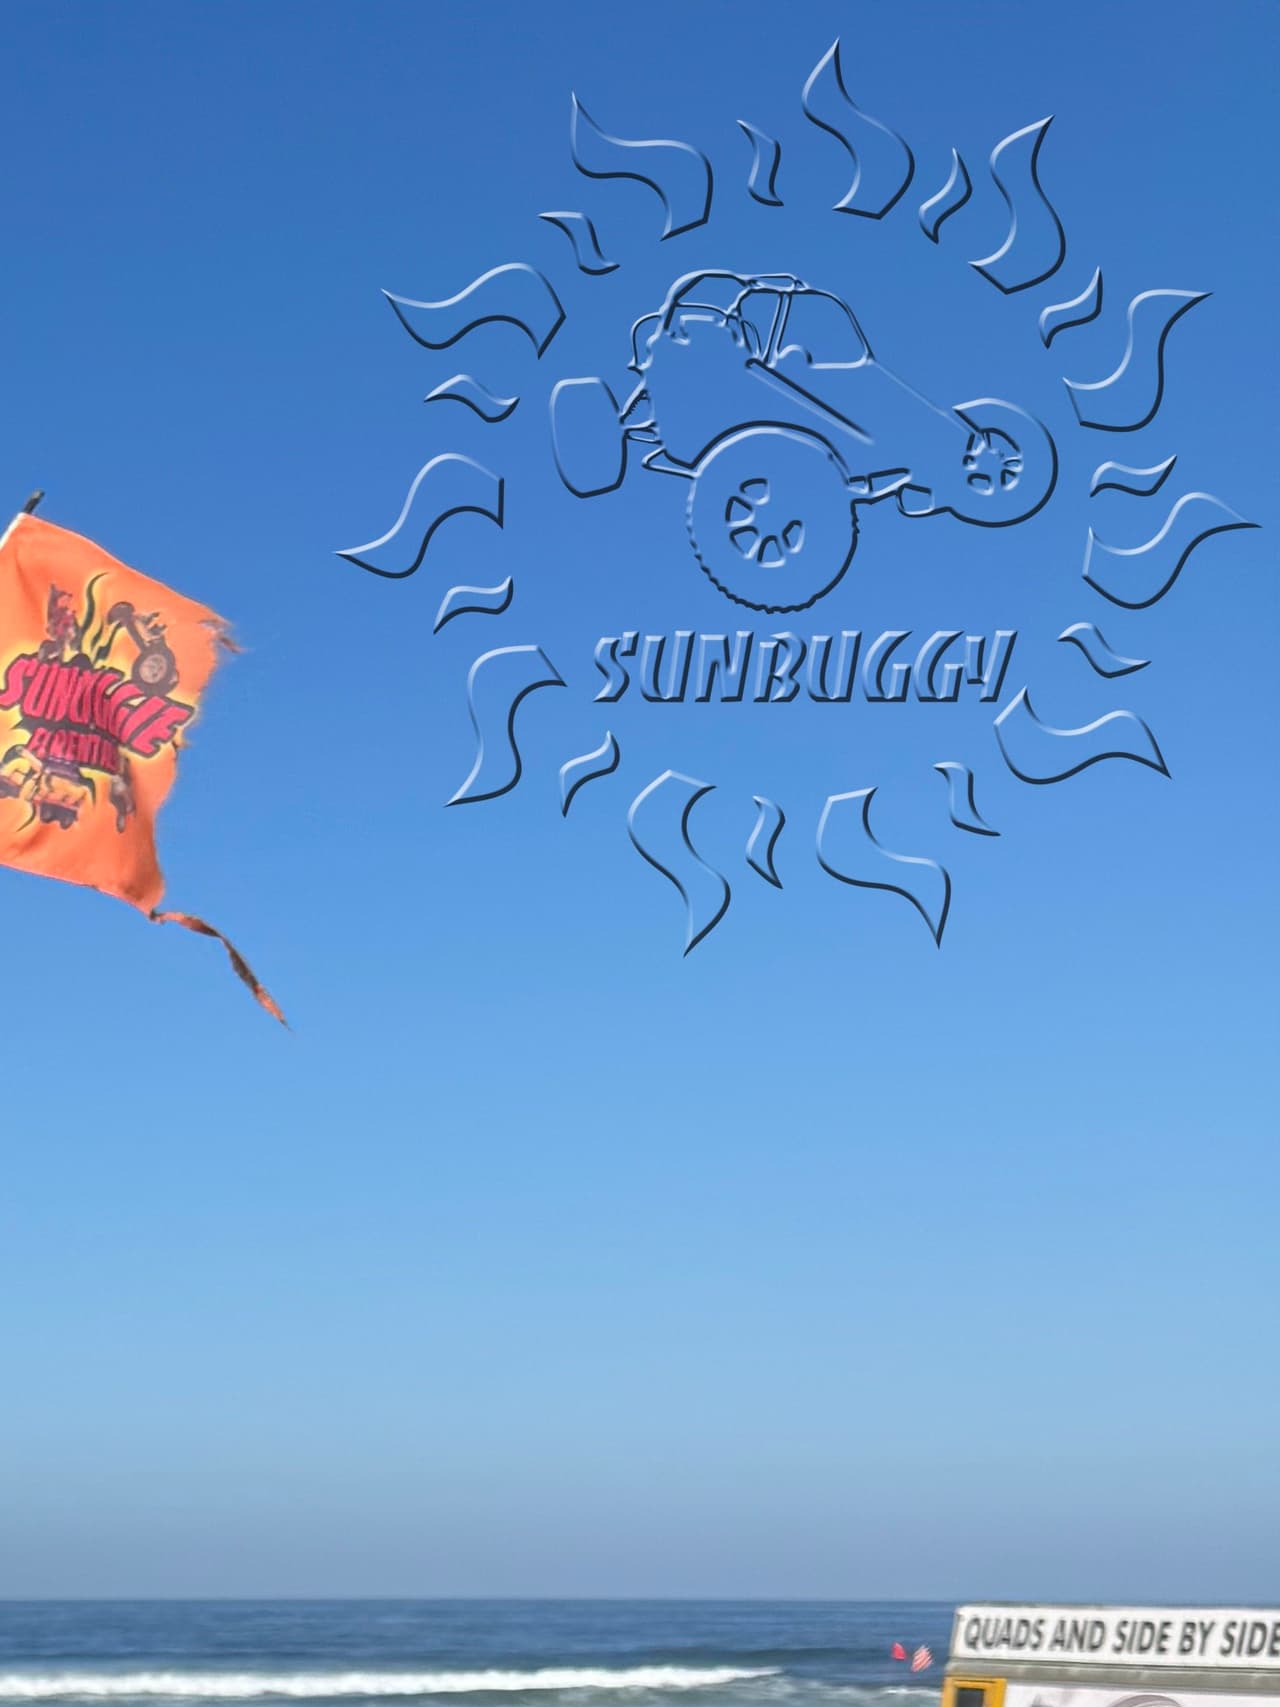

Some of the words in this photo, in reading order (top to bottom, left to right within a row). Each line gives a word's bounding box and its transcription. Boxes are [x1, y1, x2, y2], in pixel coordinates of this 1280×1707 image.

[964, 1616, 1044, 1650] QUADS
[1048, 1618, 1107, 1651] AND
[1111, 1618, 1174, 1653] SIDE
[1175, 1620, 1217, 1655] BY
